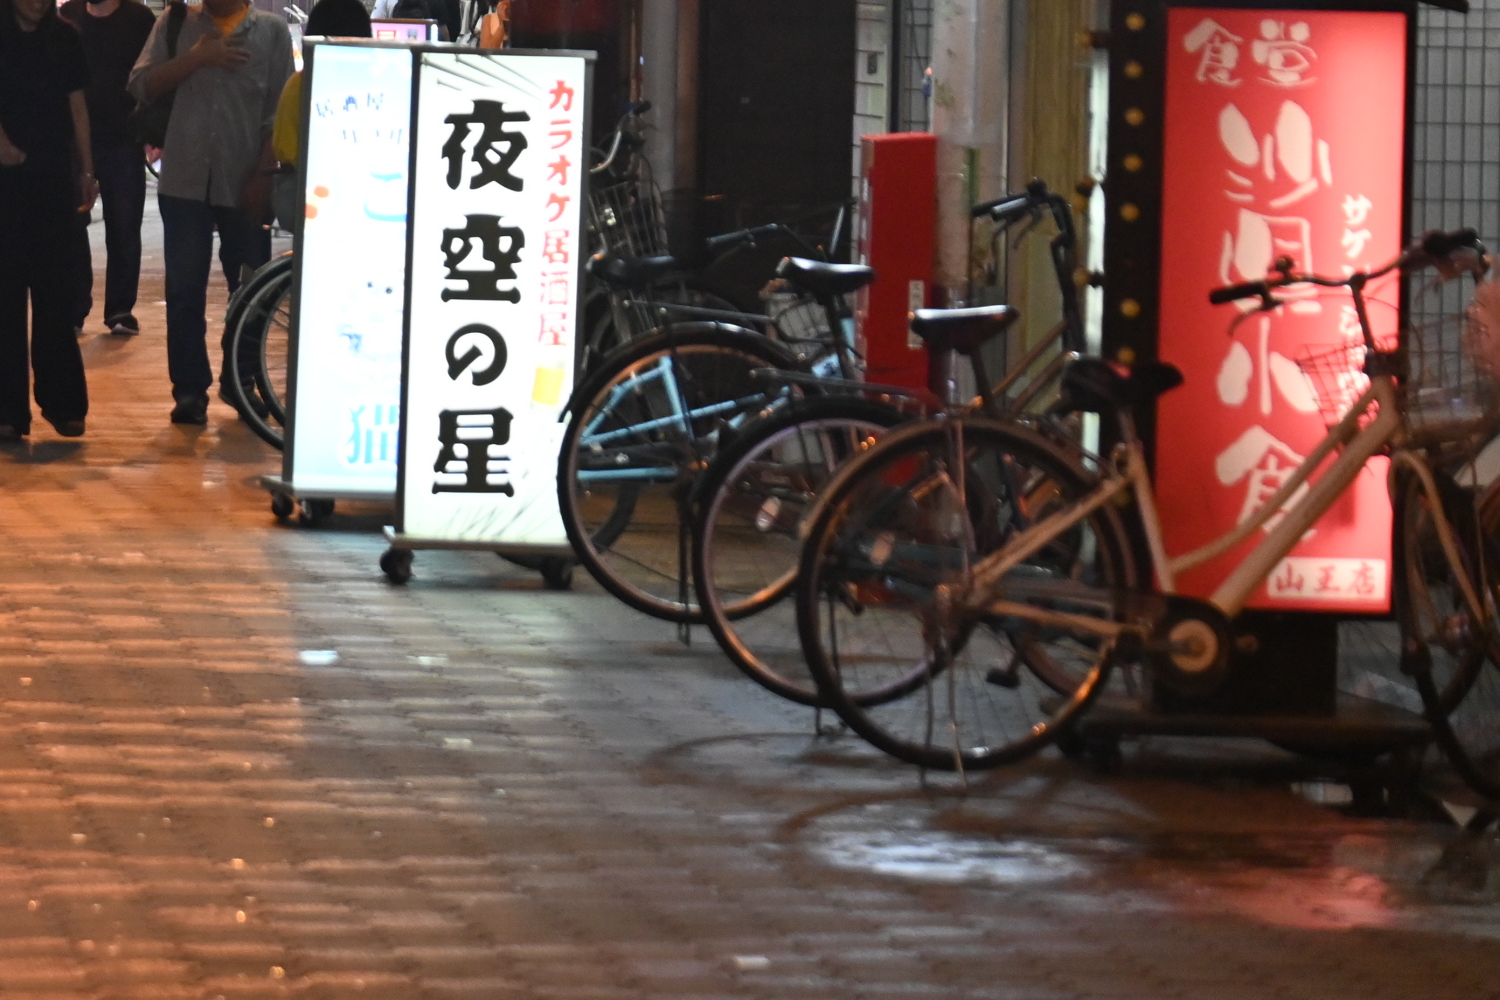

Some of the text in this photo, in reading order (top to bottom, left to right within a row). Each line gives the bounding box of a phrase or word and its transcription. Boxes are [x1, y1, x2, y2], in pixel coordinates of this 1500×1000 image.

[432, 98, 531, 498] 夜空の星
[538, 80, 574, 347] カラオケ居酒屋
